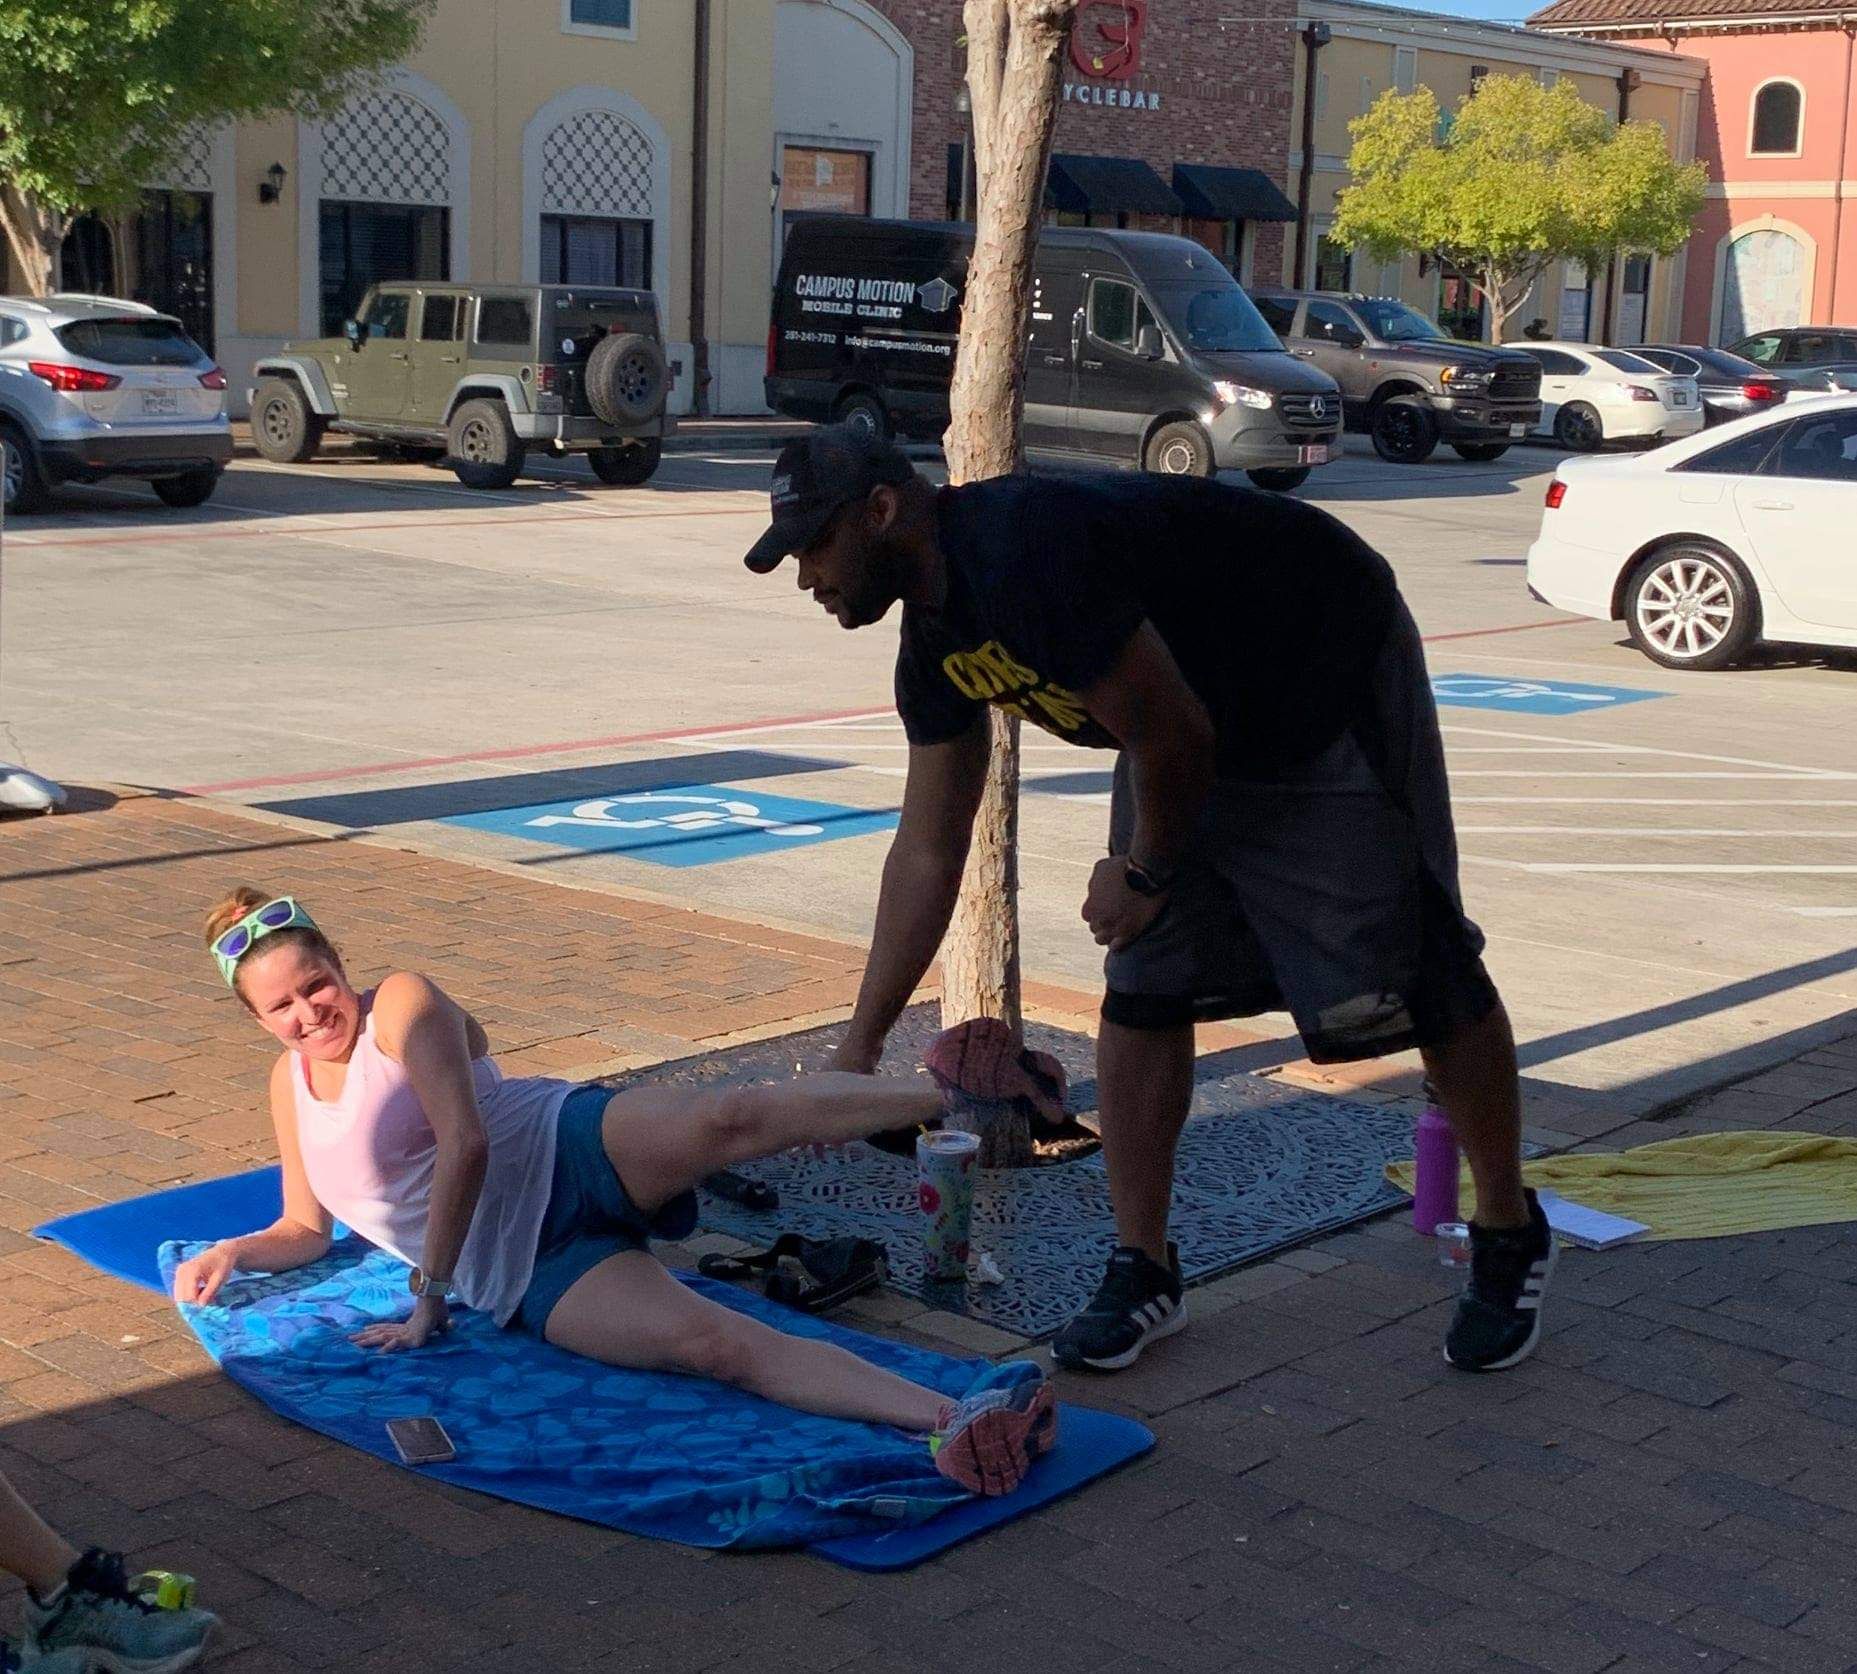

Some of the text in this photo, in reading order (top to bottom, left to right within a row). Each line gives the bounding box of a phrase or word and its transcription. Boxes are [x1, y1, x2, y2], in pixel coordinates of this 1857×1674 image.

[1062, 83, 1160, 111] YCLEBAR
[796, 275, 915, 303] CAMPUS MOTION
[802, 300, 902, 318] MOBILE CLINIC
